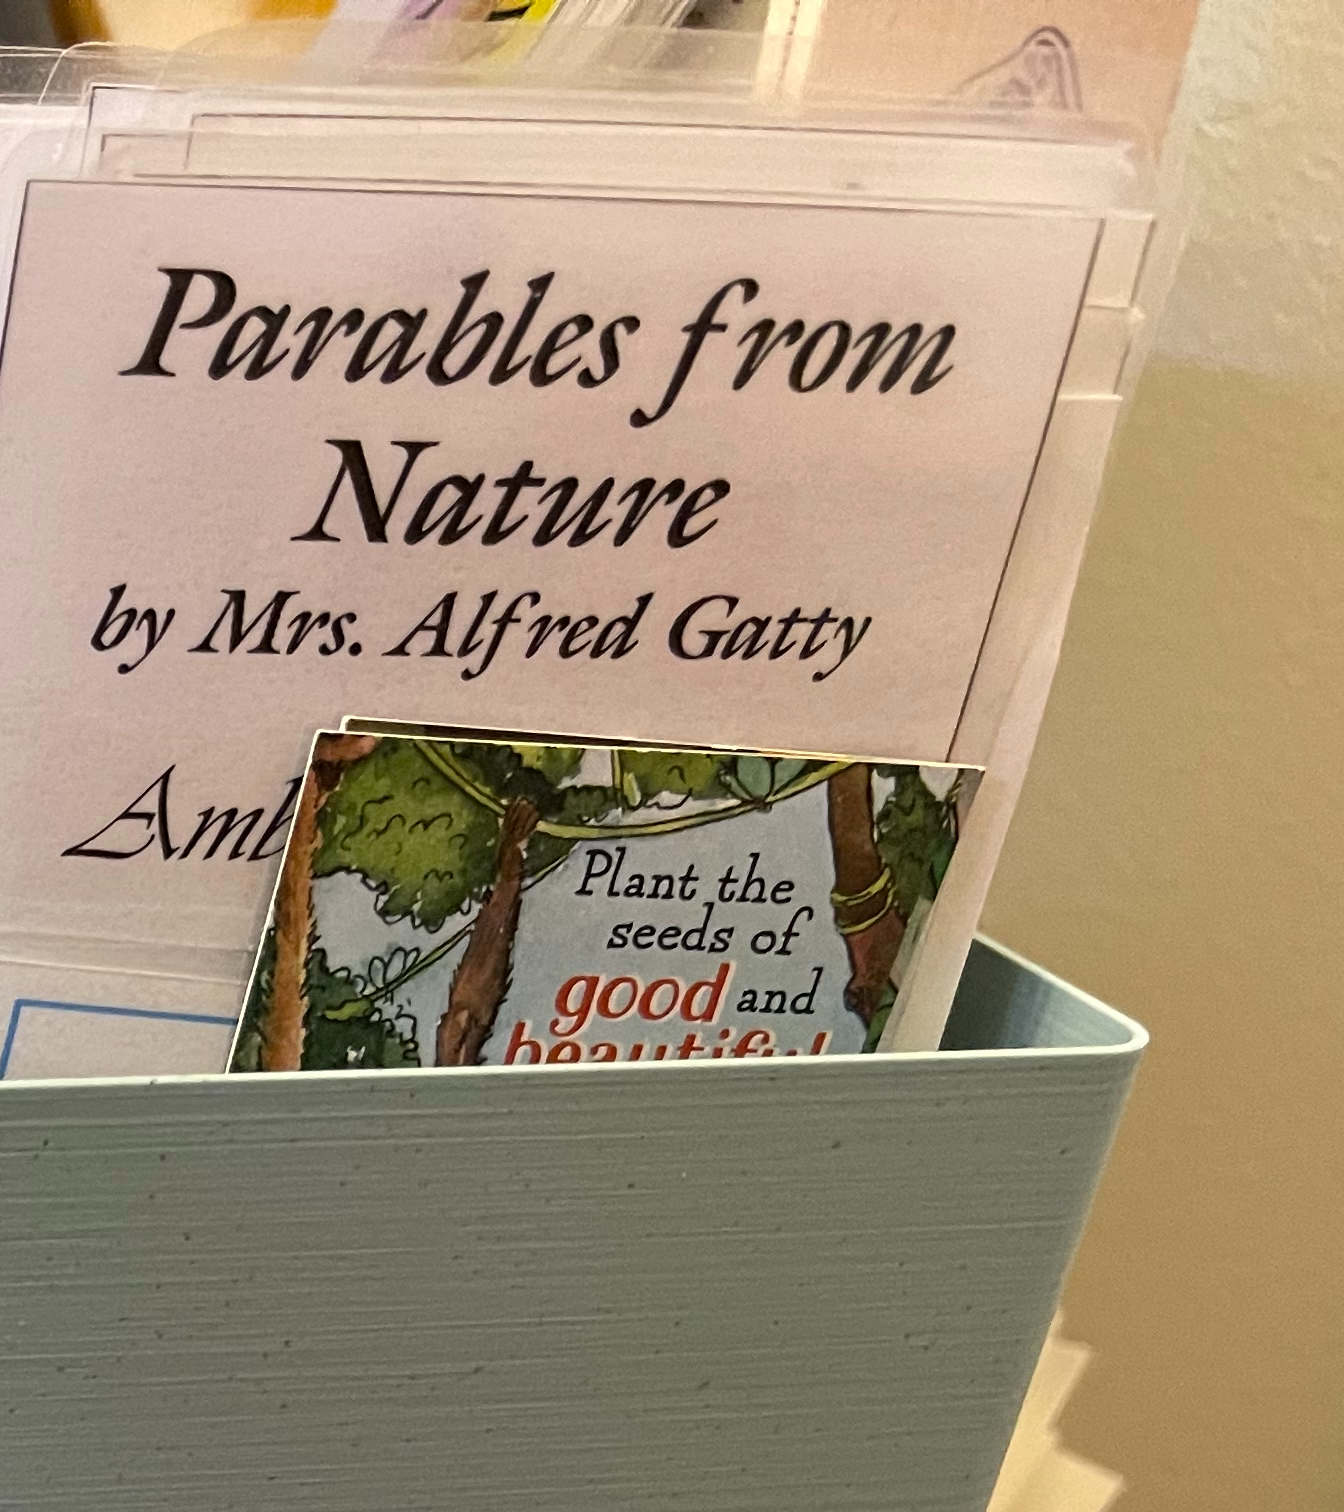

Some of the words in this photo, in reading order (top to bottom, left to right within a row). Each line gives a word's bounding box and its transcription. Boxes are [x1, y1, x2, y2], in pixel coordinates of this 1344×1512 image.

[118, 267, 640, 388] Parables
[629, 278, 959, 428] from
[290, 439, 732, 548] Nature
[89, 585, 177, 675] by
[188, 590, 363, 657] Mrs.
[384, 591, 656, 682] Alfred
[668, 595, 872, 683] Gatty
[575, 847, 699, 900] Plant
[718, 853, 795, 904] the
[607, 902, 734, 953] seeds
[750, 906, 814, 956] of
[549, 962, 732, 1037] good
[736, 967, 824, 1015] and
[503, 1021, 828, 1066] beautifl
